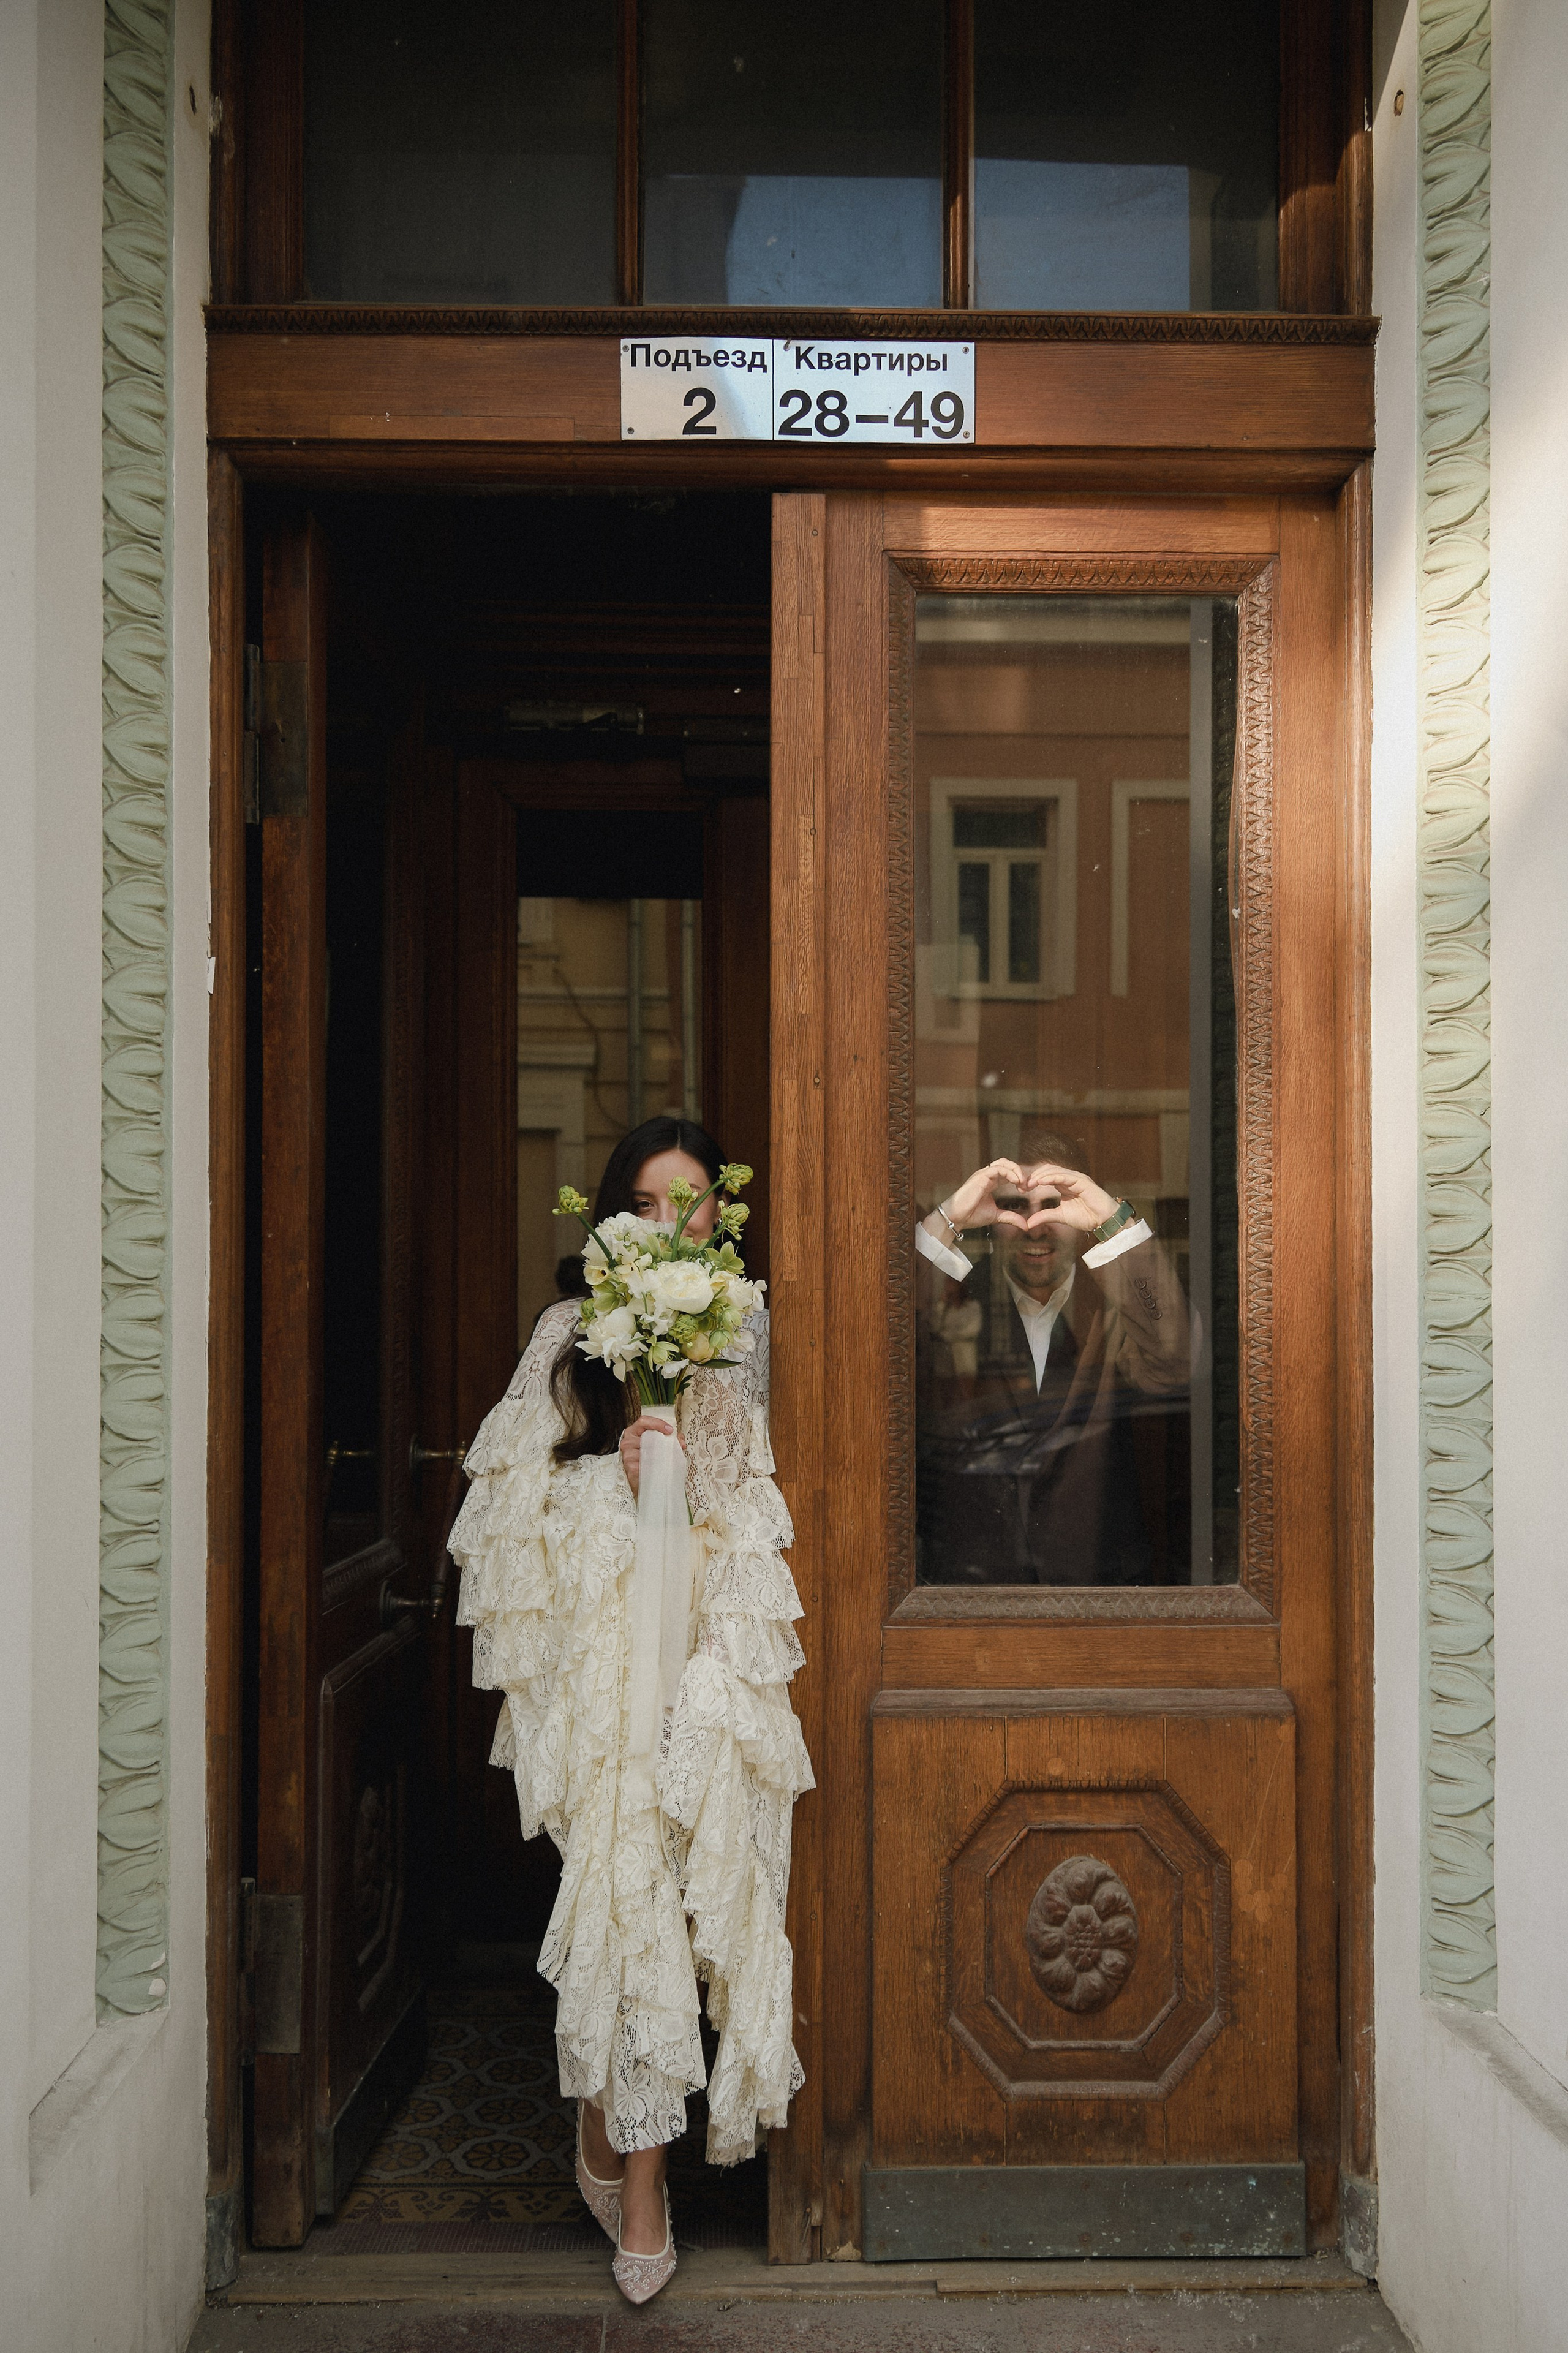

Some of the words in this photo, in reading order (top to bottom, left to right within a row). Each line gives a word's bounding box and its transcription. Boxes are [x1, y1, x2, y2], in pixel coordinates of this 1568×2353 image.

[630, 343, 767, 373] Подъезд
[795, 346, 948, 376] Квартиры
[682, 387, 717, 436] 2
